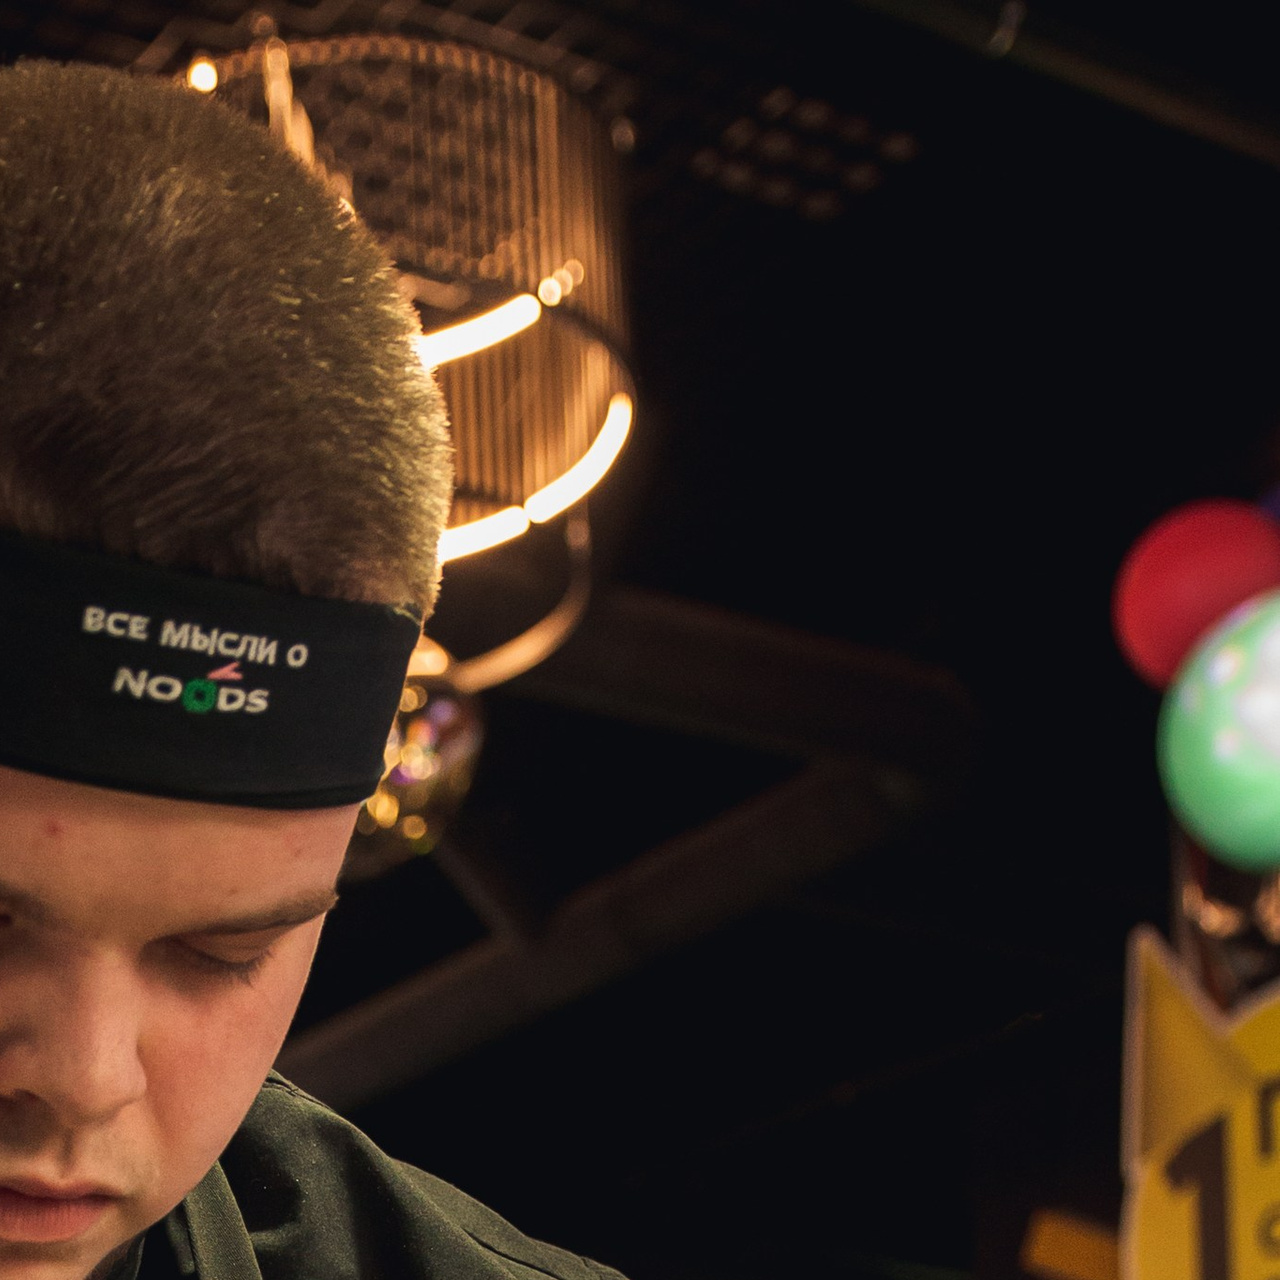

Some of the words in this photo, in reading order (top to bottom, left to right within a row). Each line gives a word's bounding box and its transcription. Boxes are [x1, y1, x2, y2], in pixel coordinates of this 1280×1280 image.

[82, 605, 150, 641] ВСЕ
[160, 619, 278, 666] МЫСЛИ
[286, 643, 309, 668] О
[113, 667, 270, 714] NOODS
